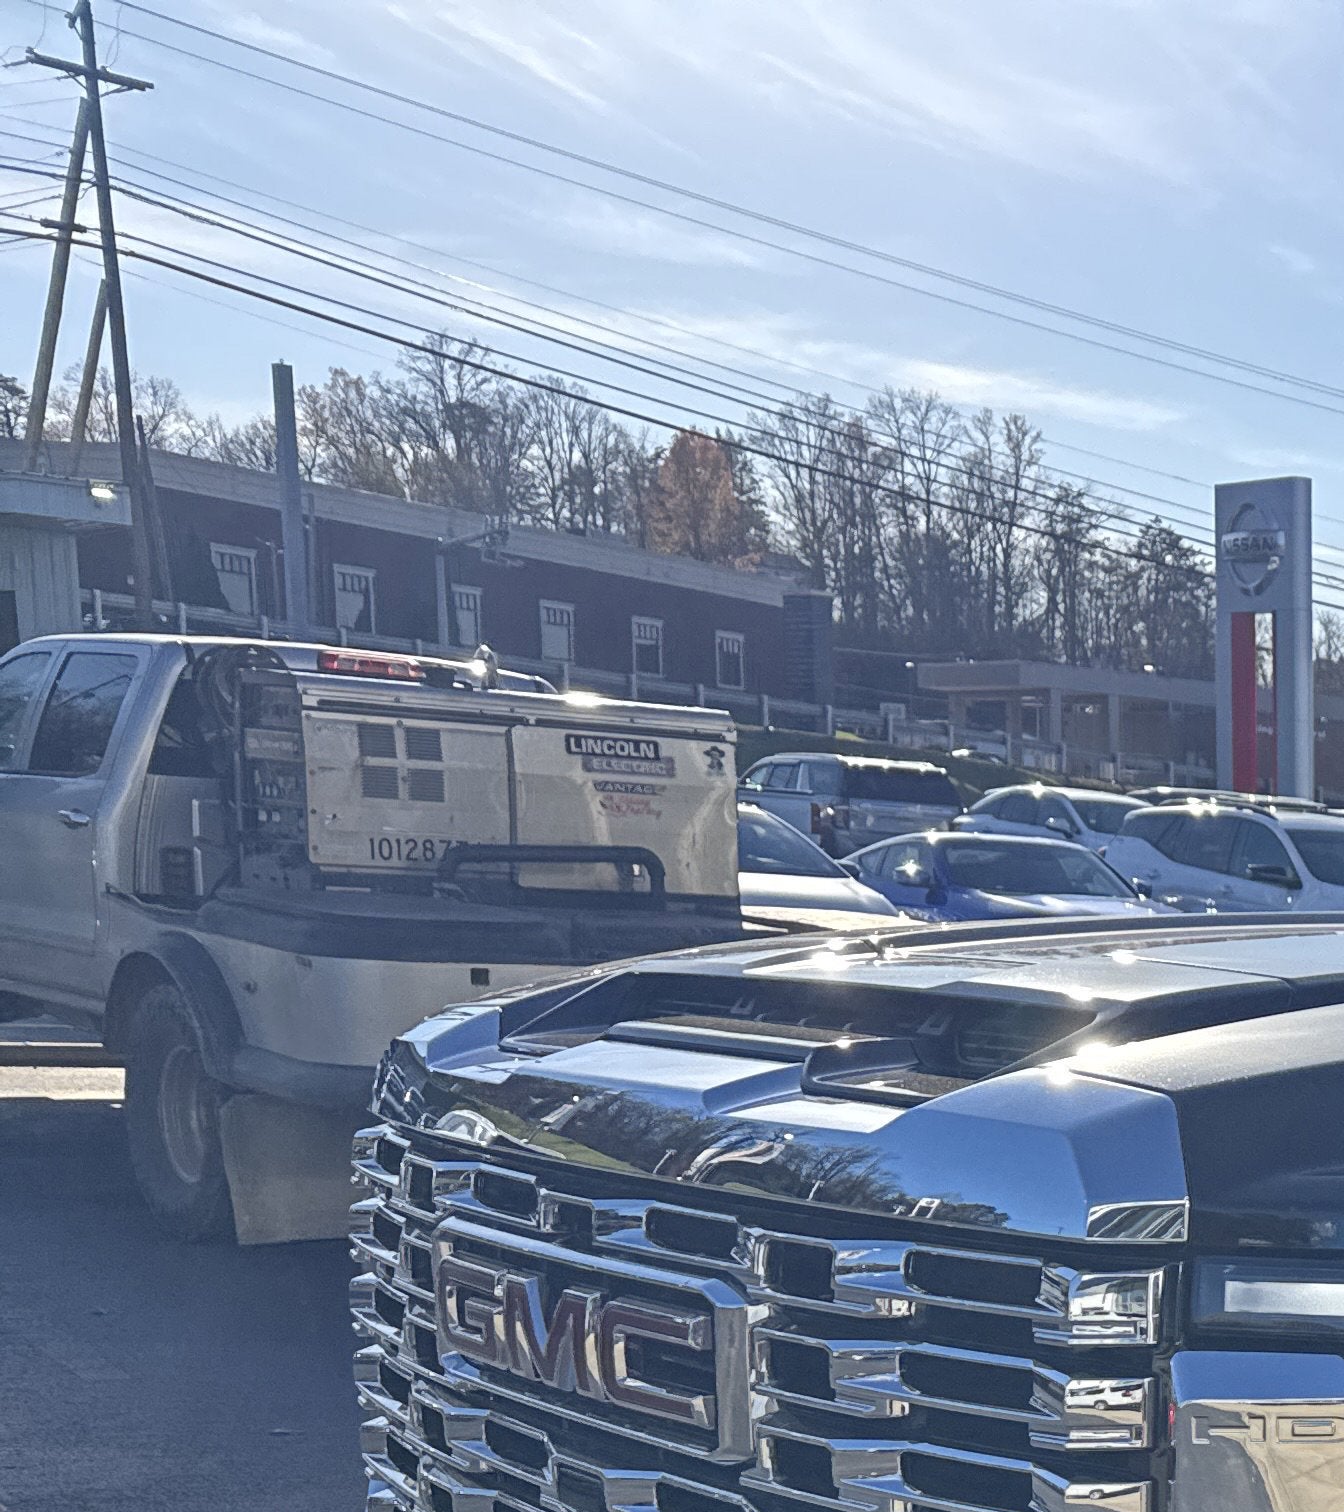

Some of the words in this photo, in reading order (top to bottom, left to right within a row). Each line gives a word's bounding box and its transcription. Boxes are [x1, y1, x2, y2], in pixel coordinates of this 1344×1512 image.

[569, 736, 655, 759] LINCOLN
[596, 782, 654, 795] VANTAG
[369, 837, 468, 862] 101287
[435, 1254, 716, 1431] GMC
